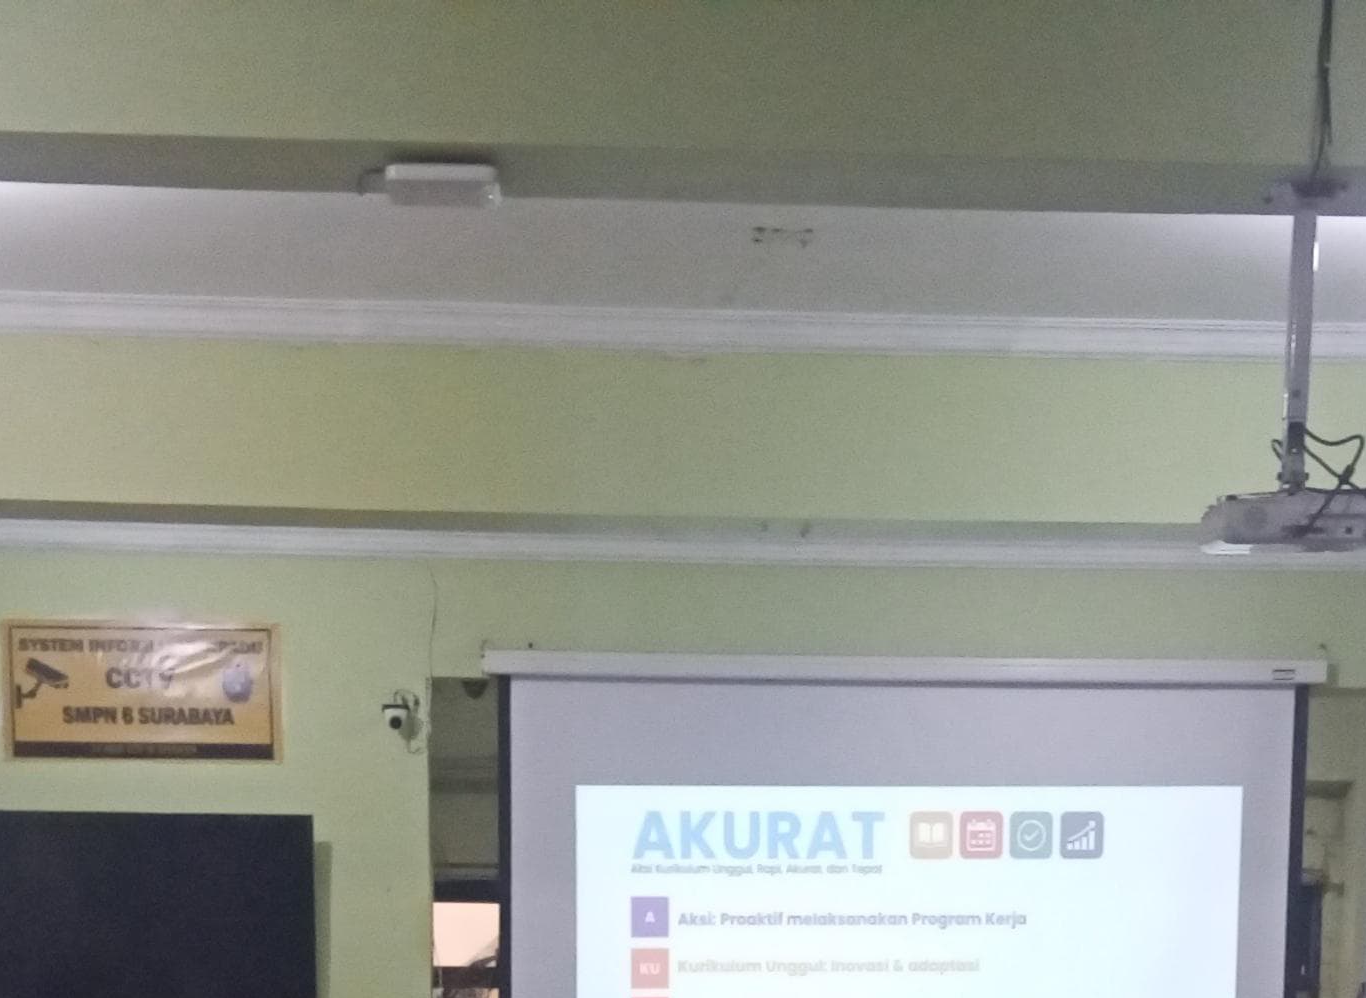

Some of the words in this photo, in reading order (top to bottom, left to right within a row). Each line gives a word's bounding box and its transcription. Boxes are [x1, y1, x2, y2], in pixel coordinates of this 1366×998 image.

[62, 706, 117, 724] SMPN
[121, 706, 134, 725] 6
[137, 706, 235, 726] SURABAYA
[632, 810, 885, 860] AKURAT
[644, 911, 656, 924] A
[677, 911, 716, 926] Aksi:
[720, 911, 784, 926] Proaktif
[786, 911, 908, 926] melaksanakan
[911, 911, 982, 930] Program
[985, 910, 1027, 930] Kerja
[638, 962, 661, 975] KU
[677, 959, 762, 973] Kurikulum
[908, 957, 981, 976] adaptasi
